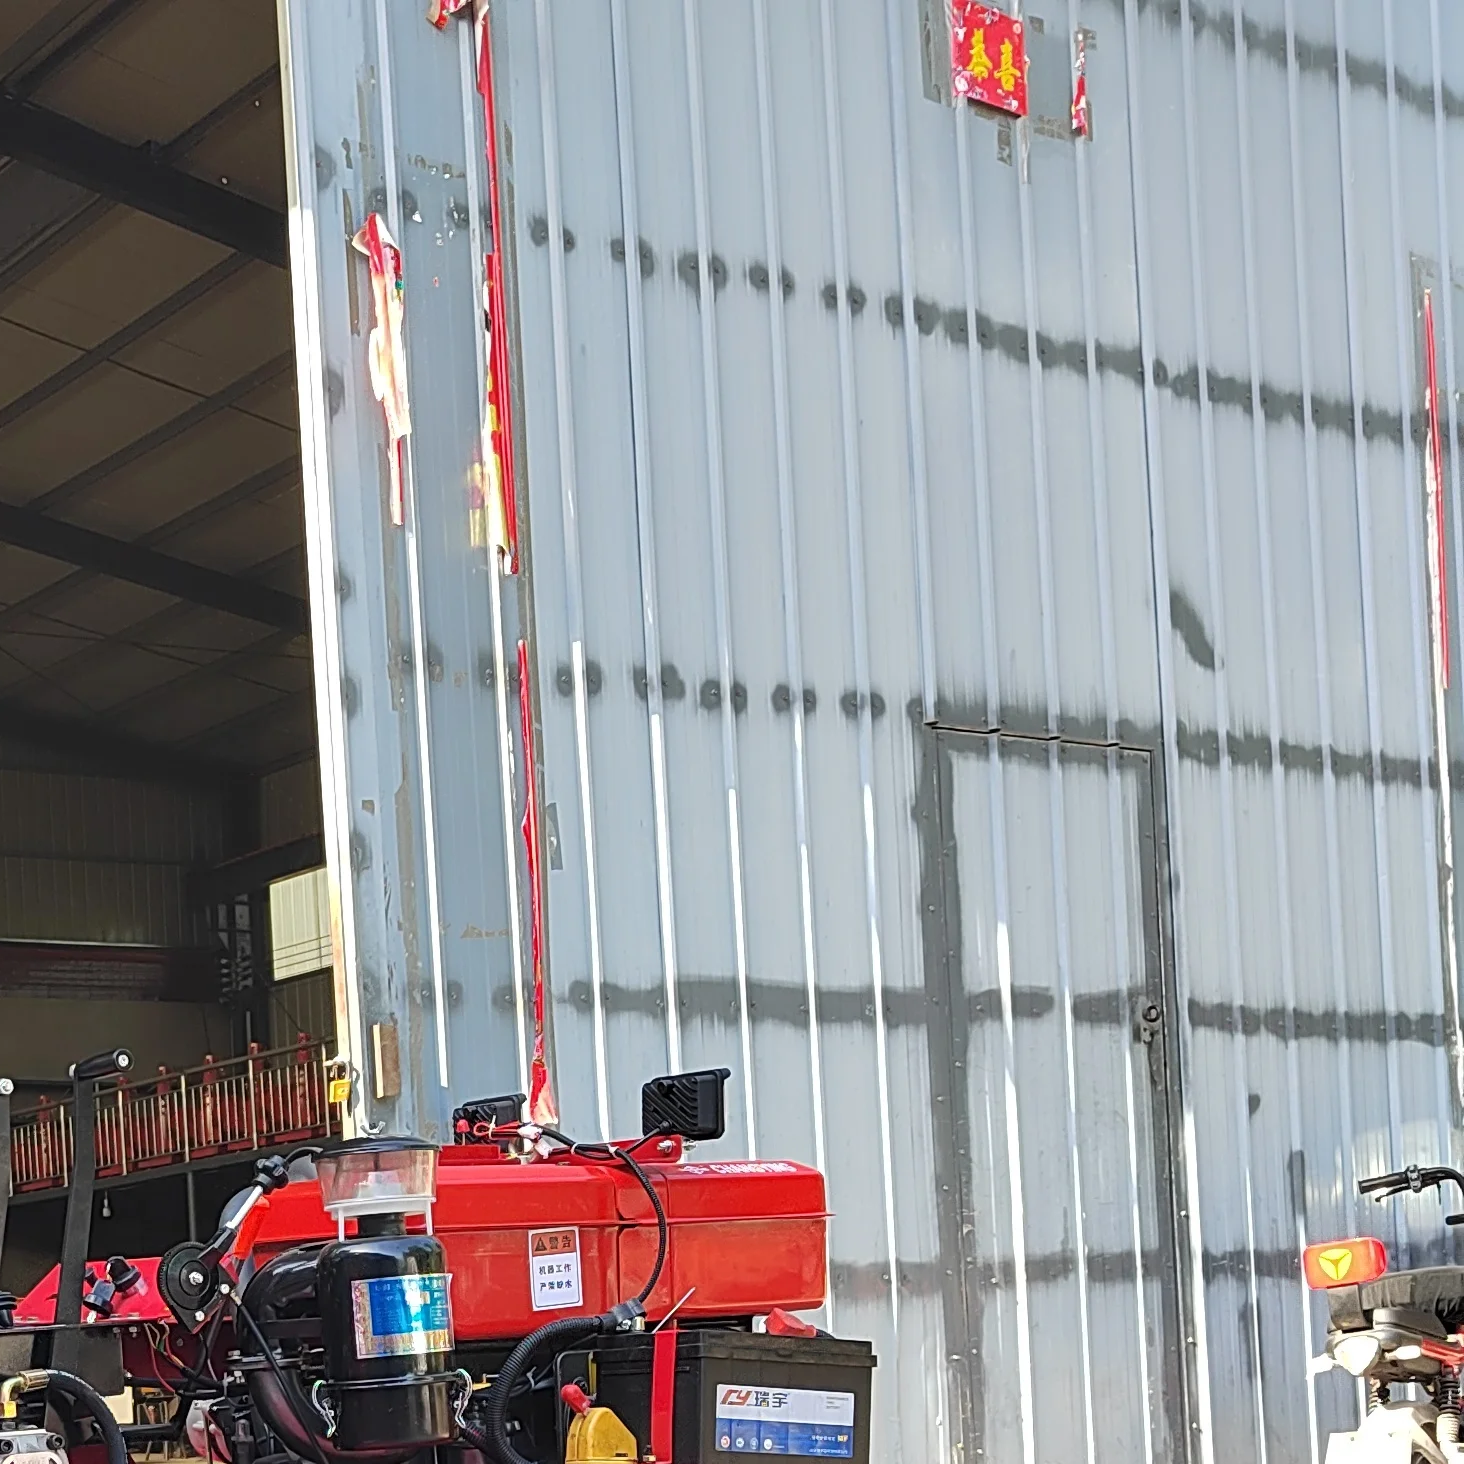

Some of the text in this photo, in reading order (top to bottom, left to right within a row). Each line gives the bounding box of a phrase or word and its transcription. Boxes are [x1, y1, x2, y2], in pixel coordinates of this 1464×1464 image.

[549, 1235, 571, 1250] 警告
[539, 1263, 572, 1276] 机器工作
